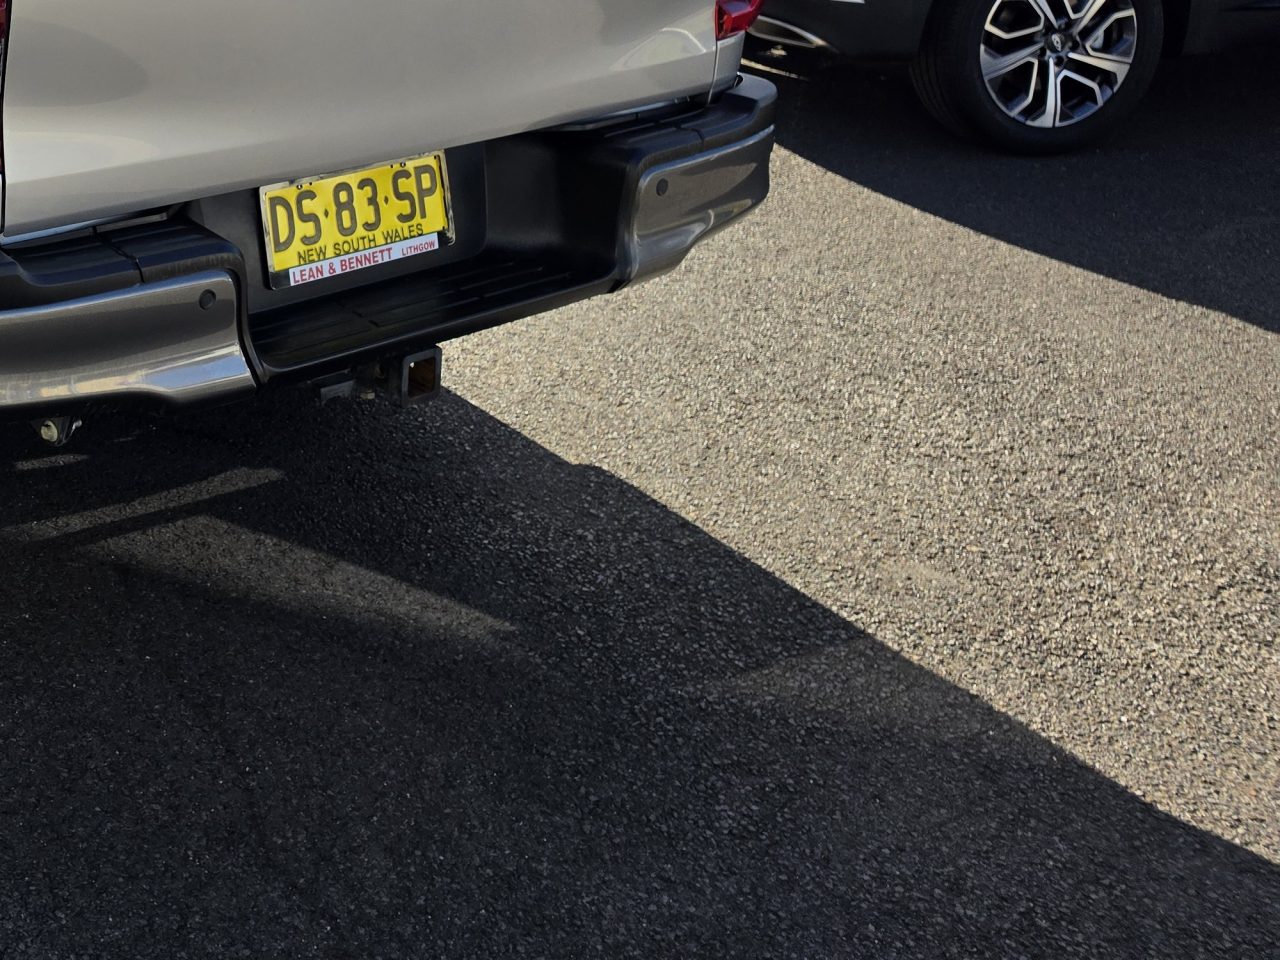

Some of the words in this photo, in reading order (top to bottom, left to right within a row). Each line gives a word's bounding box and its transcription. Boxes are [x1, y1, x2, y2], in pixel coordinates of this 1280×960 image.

[292, 264, 324, 284] LEAN
[328, 262, 336, 275] &
[340, 247, 393, 271] BENNETT
[401, 240, 436, 257] LITHGOW
[297, 246, 327, 264] NEW
[333, 233, 377, 256] SOUTH
[382, 223, 424, 242] WALES
